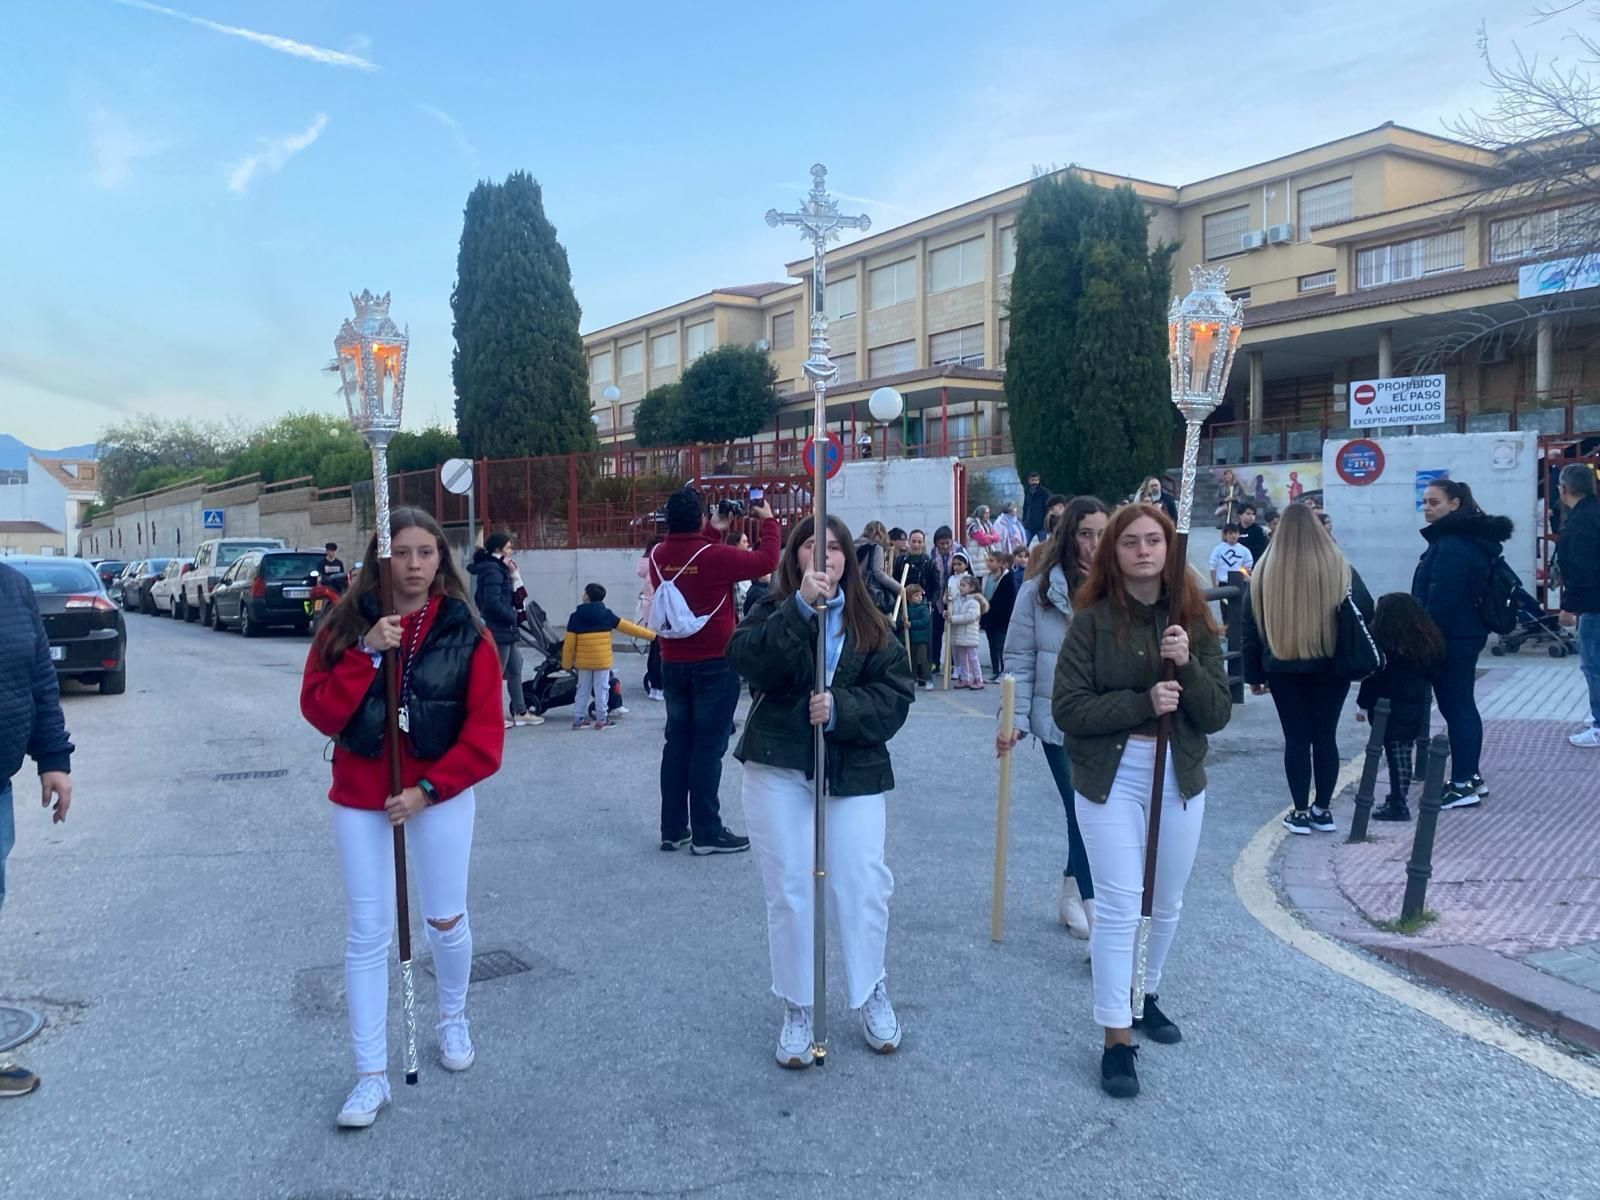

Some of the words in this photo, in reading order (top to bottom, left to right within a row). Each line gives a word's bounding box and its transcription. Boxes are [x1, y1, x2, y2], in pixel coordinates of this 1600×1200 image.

[1378, 379, 1441, 391] PROHIBIDO
[1393, 393, 1406, 402] EL
[1410, 390, 1441, 400] PASO
[1366, 407, 1373, 415] A
[1353, 416, 1387, 425] EXCEPTO
[1389, 414, 1441, 424] AUTORIZADOS
